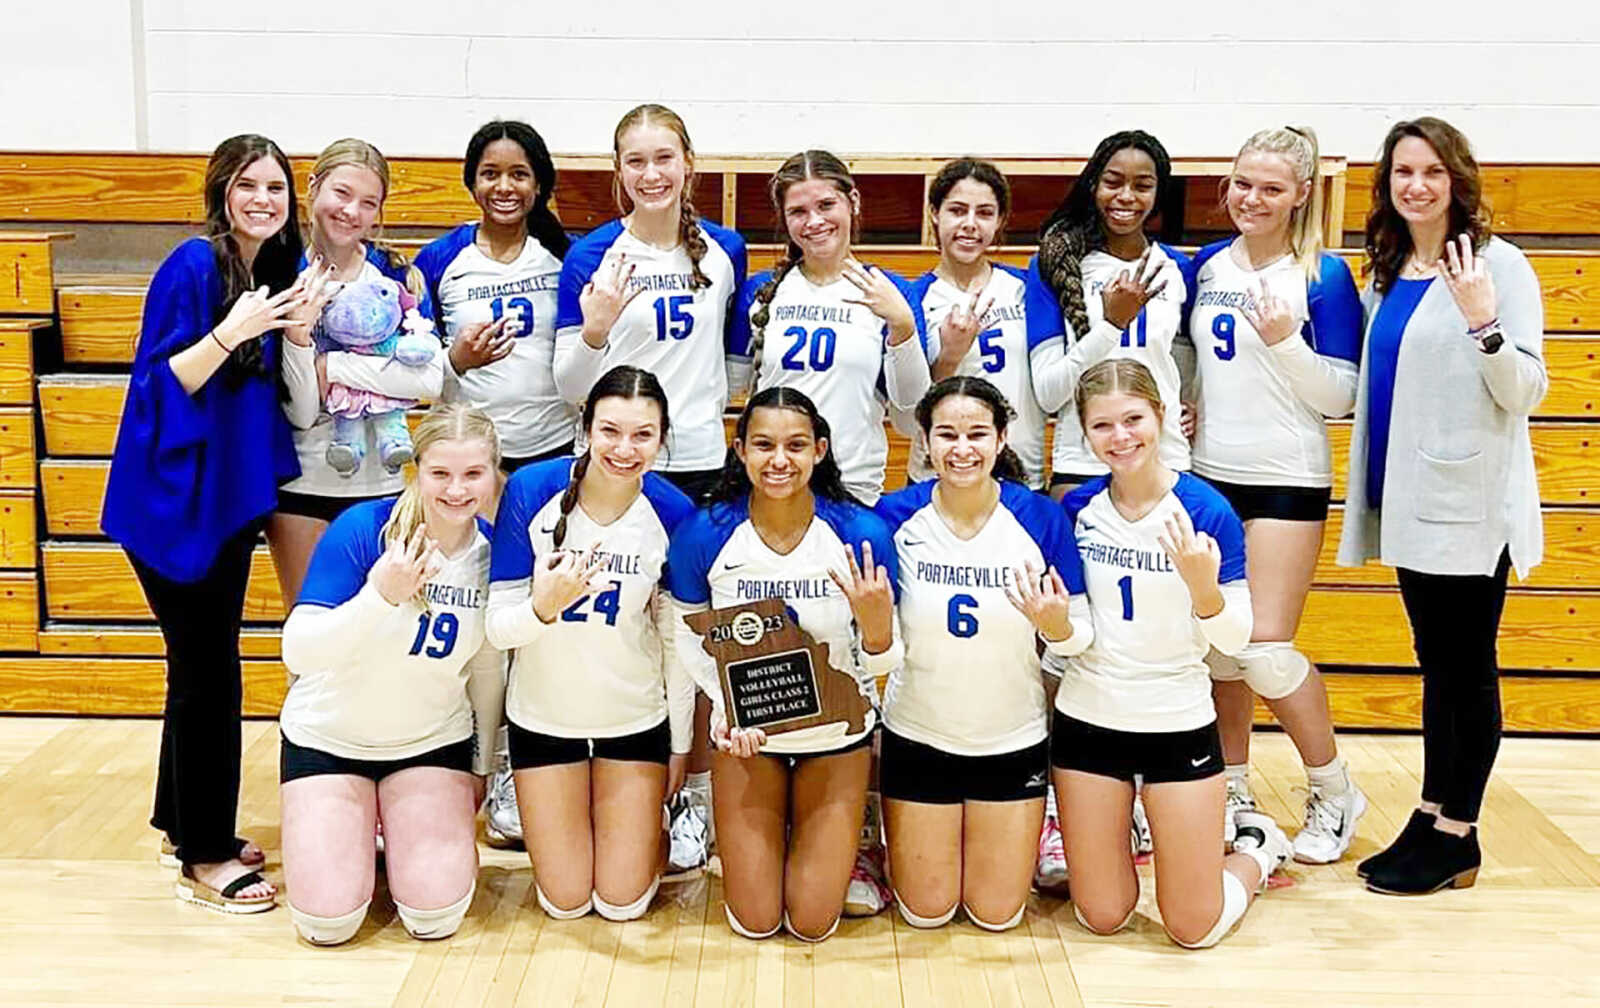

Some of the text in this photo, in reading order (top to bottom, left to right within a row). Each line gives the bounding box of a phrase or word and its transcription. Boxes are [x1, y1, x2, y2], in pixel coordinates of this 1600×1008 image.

[490, 297, 534, 338] 13
[653, 294, 695, 341] 15
[775, 304, 853, 324] PORTAGEVILLE
[781, 326, 837, 372] 20
[978, 328, 1006, 374] 5
[1211, 313, 1236, 362] 9
[916, 560, 1011, 588] PORTAGEVILLE
[1086, 542, 1174, 573] PORTAGEVILLE
[561, 580, 622, 627] 24
[737, 578, 831, 600] PORTAGEVILLE
[1117, 575, 1134, 621] 1
[711, 625, 732, 642] 20
[763, 614, 784, 633] 23
[947, 593, 980, 639] 6
[409, 612, 460, 660] 19
[739, 673, 806, 693] VOLLEYBALL
[746, 662, 792, 679] DISTRICT
[740, 693, 772, 706] GIRLS
[770, 686, 803, 700] CLASS
[745, 699, 809, 719] FIRST PLACE
